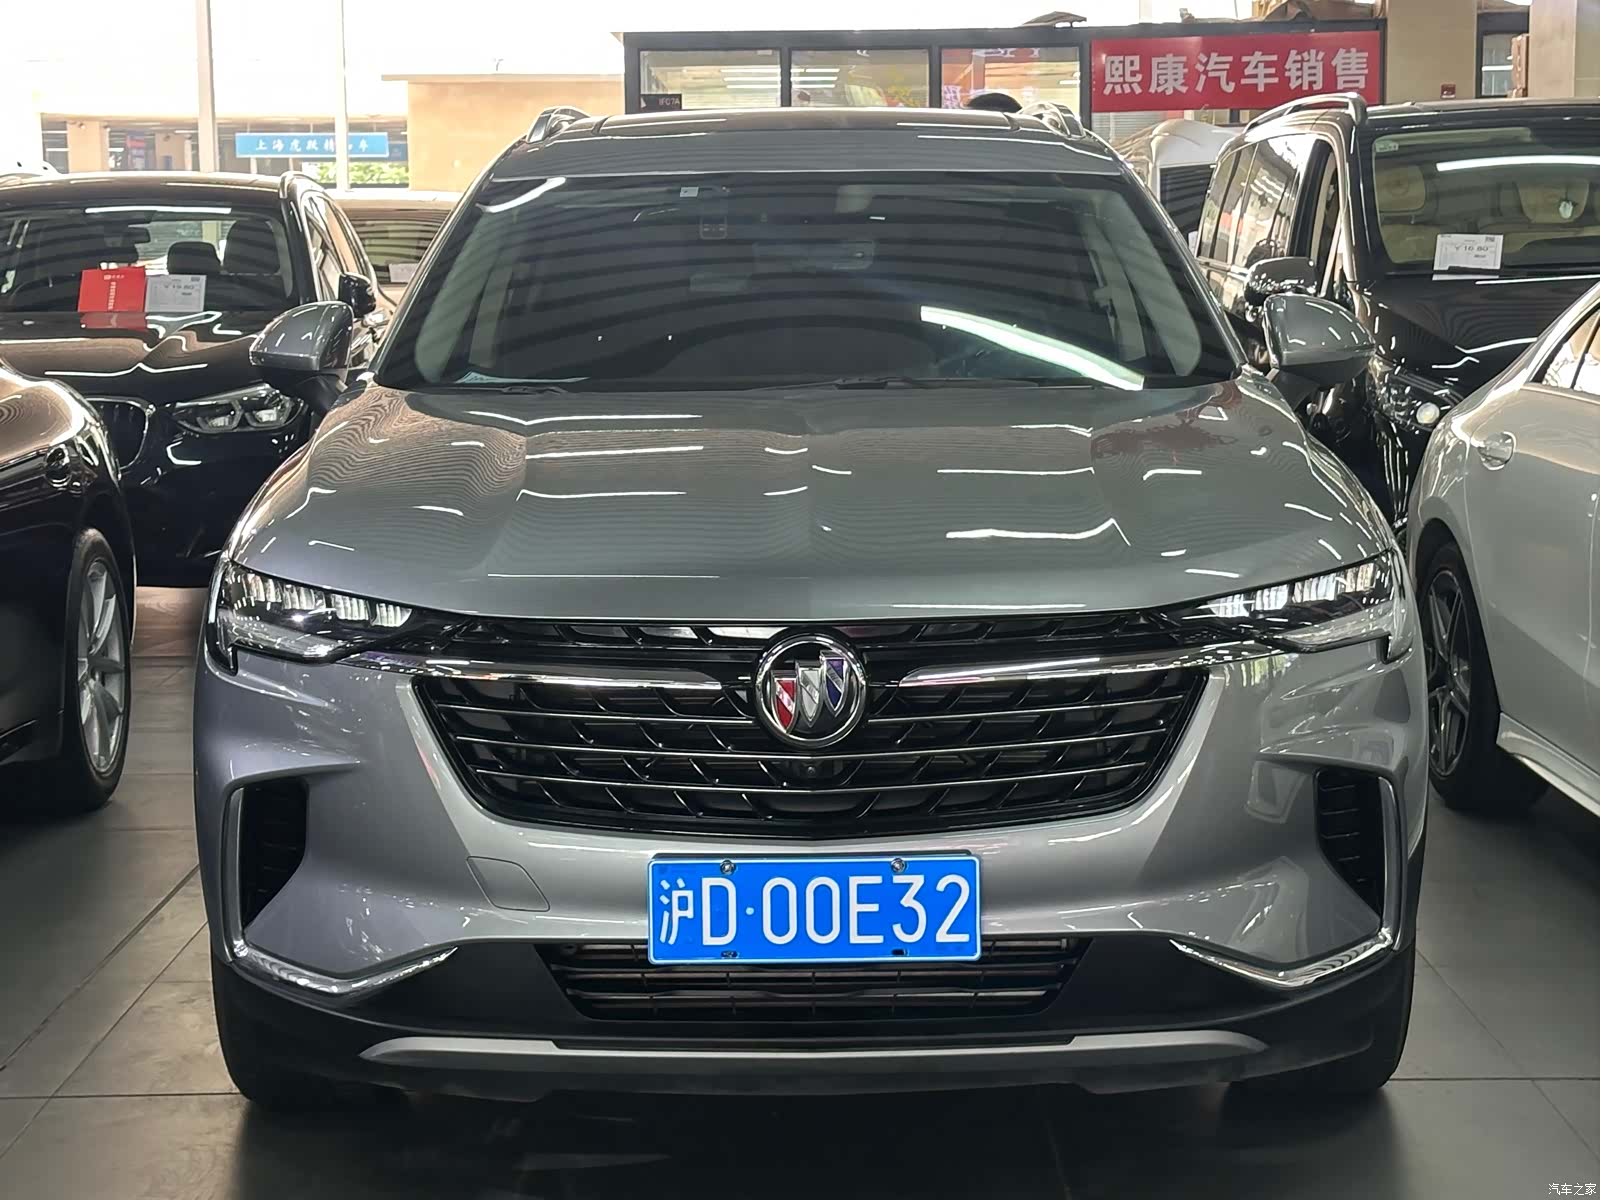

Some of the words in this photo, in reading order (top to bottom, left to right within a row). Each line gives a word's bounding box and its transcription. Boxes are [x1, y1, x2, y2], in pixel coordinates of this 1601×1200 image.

[1103, 48, 1369, 95] 熙康汽车销售
[255, 138, 369, 152] 上海虎跃精车
[660, 875, 970, 945] 沪D·00E32
